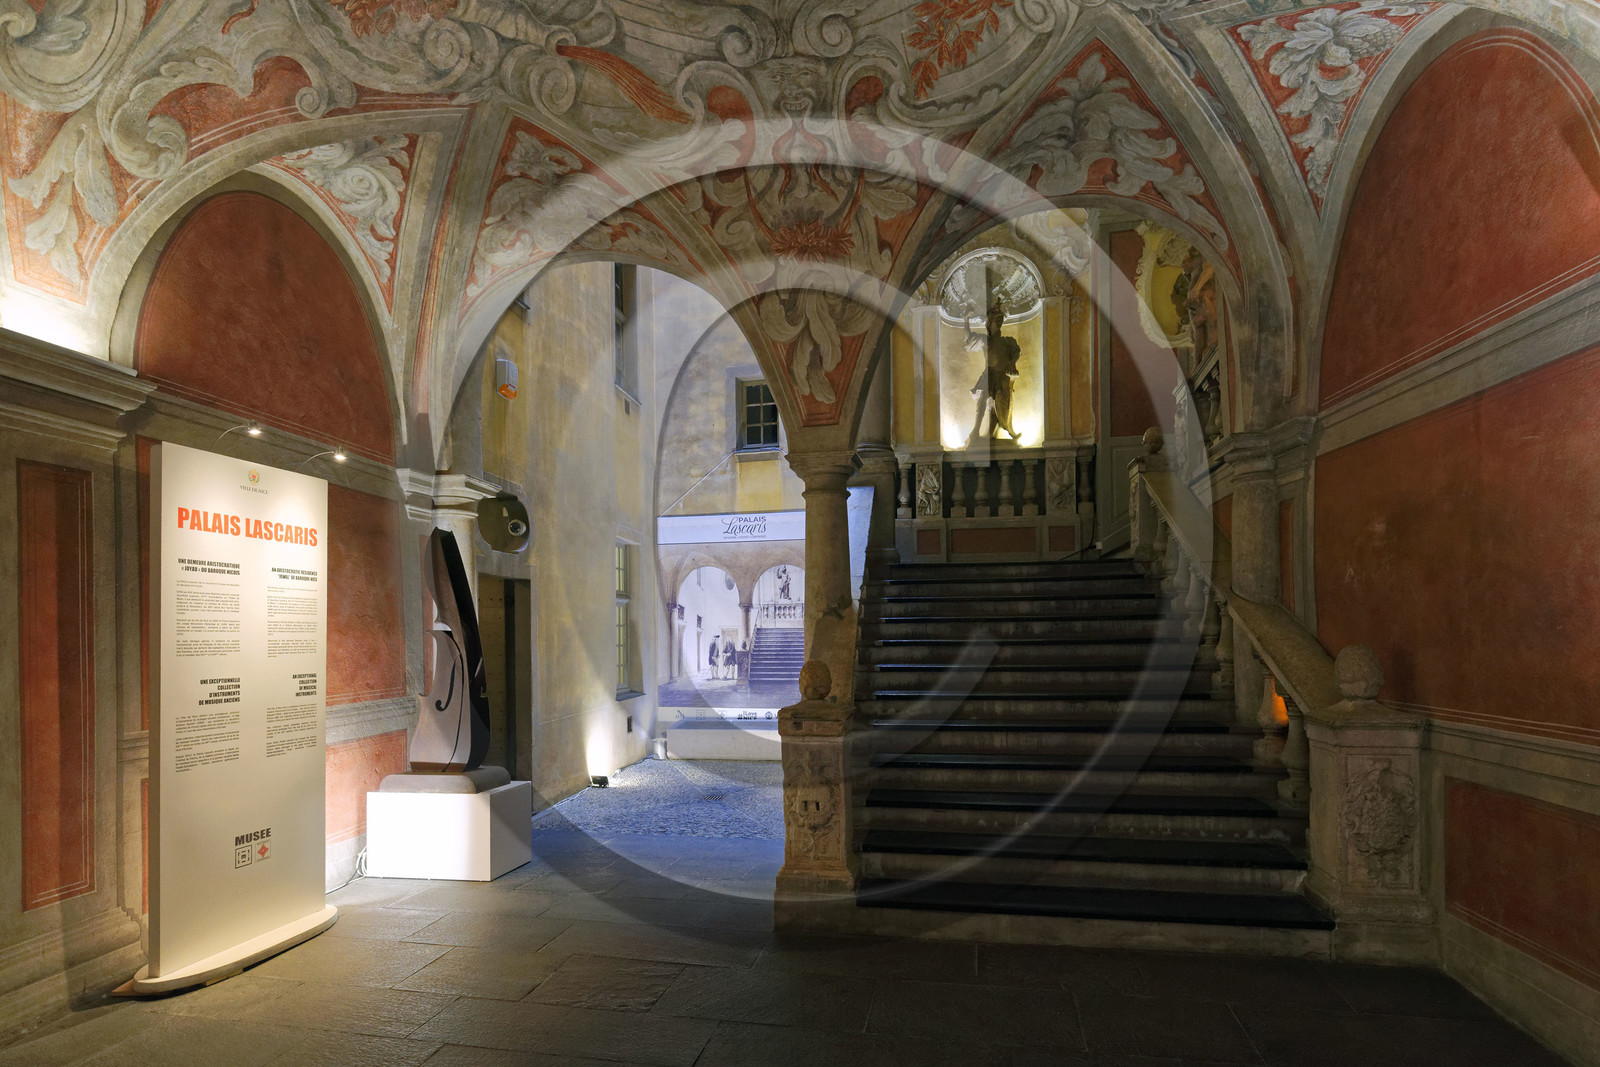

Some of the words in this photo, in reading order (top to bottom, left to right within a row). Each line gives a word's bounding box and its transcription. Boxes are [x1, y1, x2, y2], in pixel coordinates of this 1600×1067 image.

[738, 515, 767, 523] PALAIS
[177, 506, 241, 537] PALAIS
[245, 517, 318, 547] LASCARIS
[721, 516, 767, 536] Lascaris
[187, 558, 206, 566] DEMEURE
[207, 560, 240, 569] ARISTOCRATIQUE
[208, 567, 226, 575] BAROQUE
[277, 567, 300, 575] ARISTOCRATIC
[235, 827, 272, 847] MUSEE
